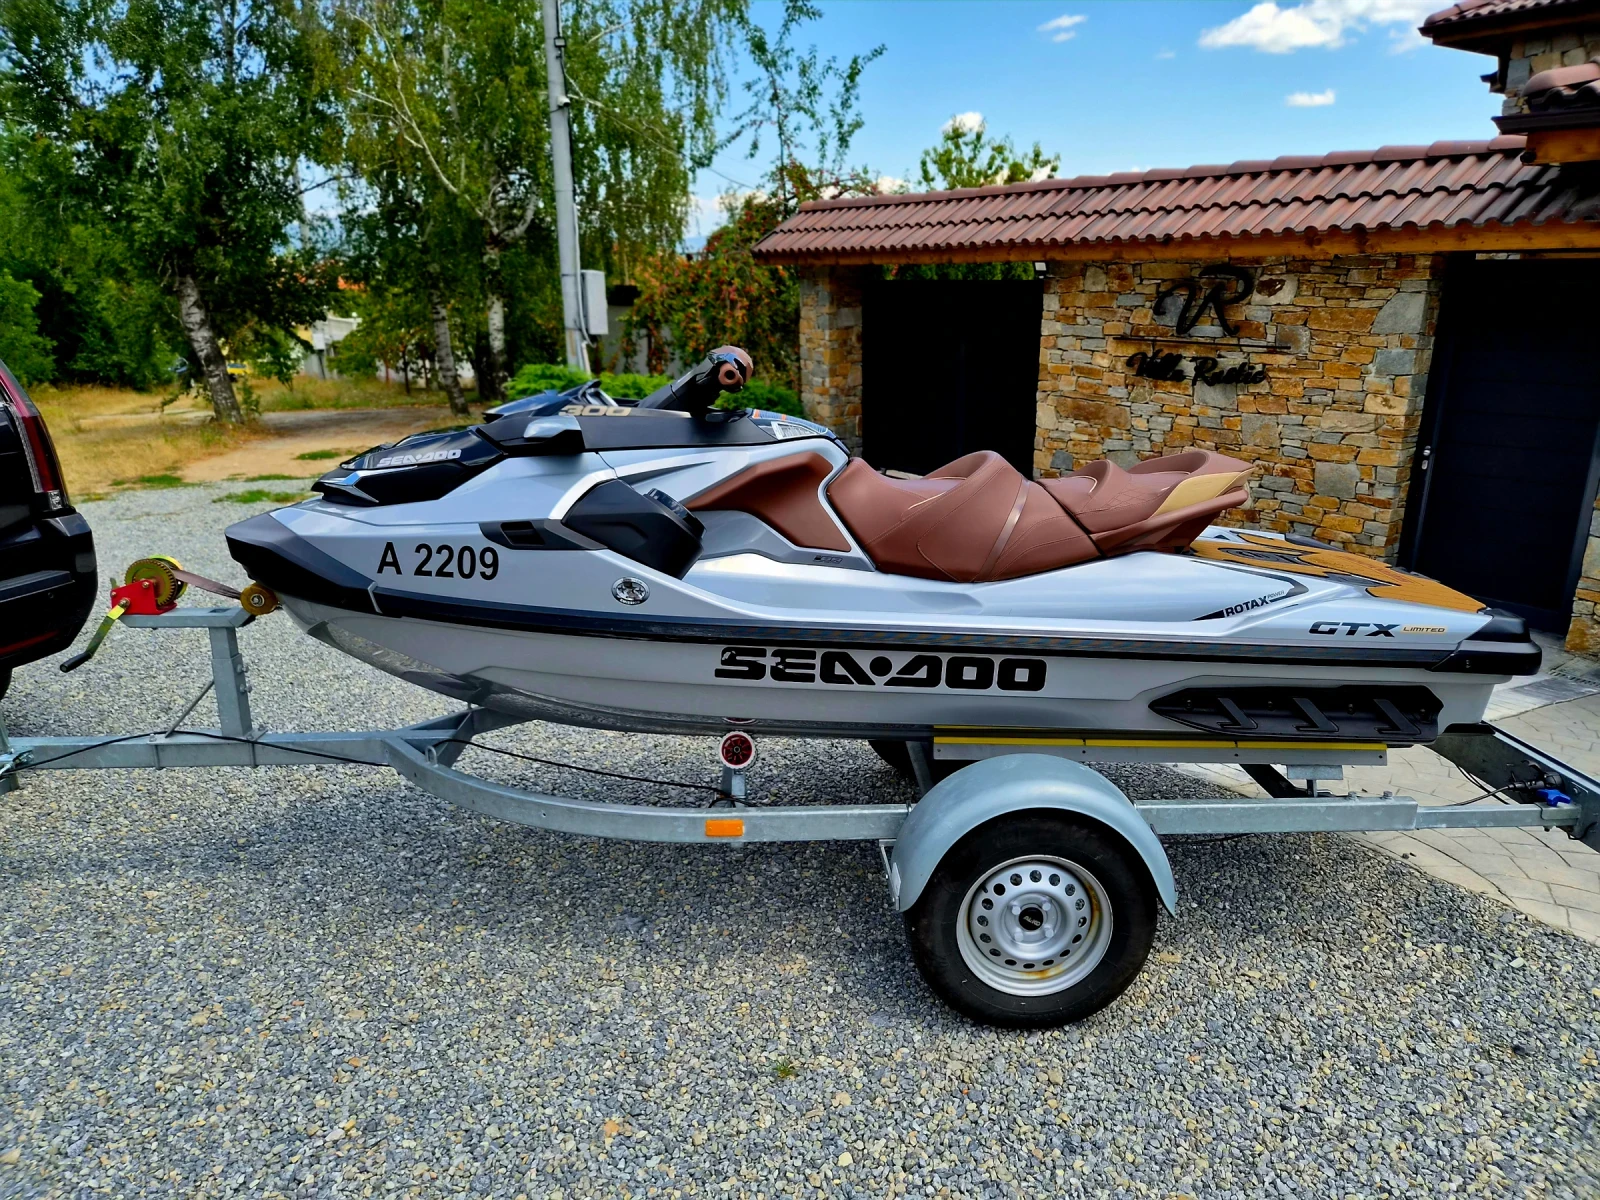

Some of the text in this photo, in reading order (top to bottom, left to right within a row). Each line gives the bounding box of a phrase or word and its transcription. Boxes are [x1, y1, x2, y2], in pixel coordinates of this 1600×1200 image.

[559, 404, 632, 417] 300
[376, 541, 500, 581] A 2209
[1224, 595, 1270, 618] ROTAX
[1308, 620, 1400, 637] GTX
